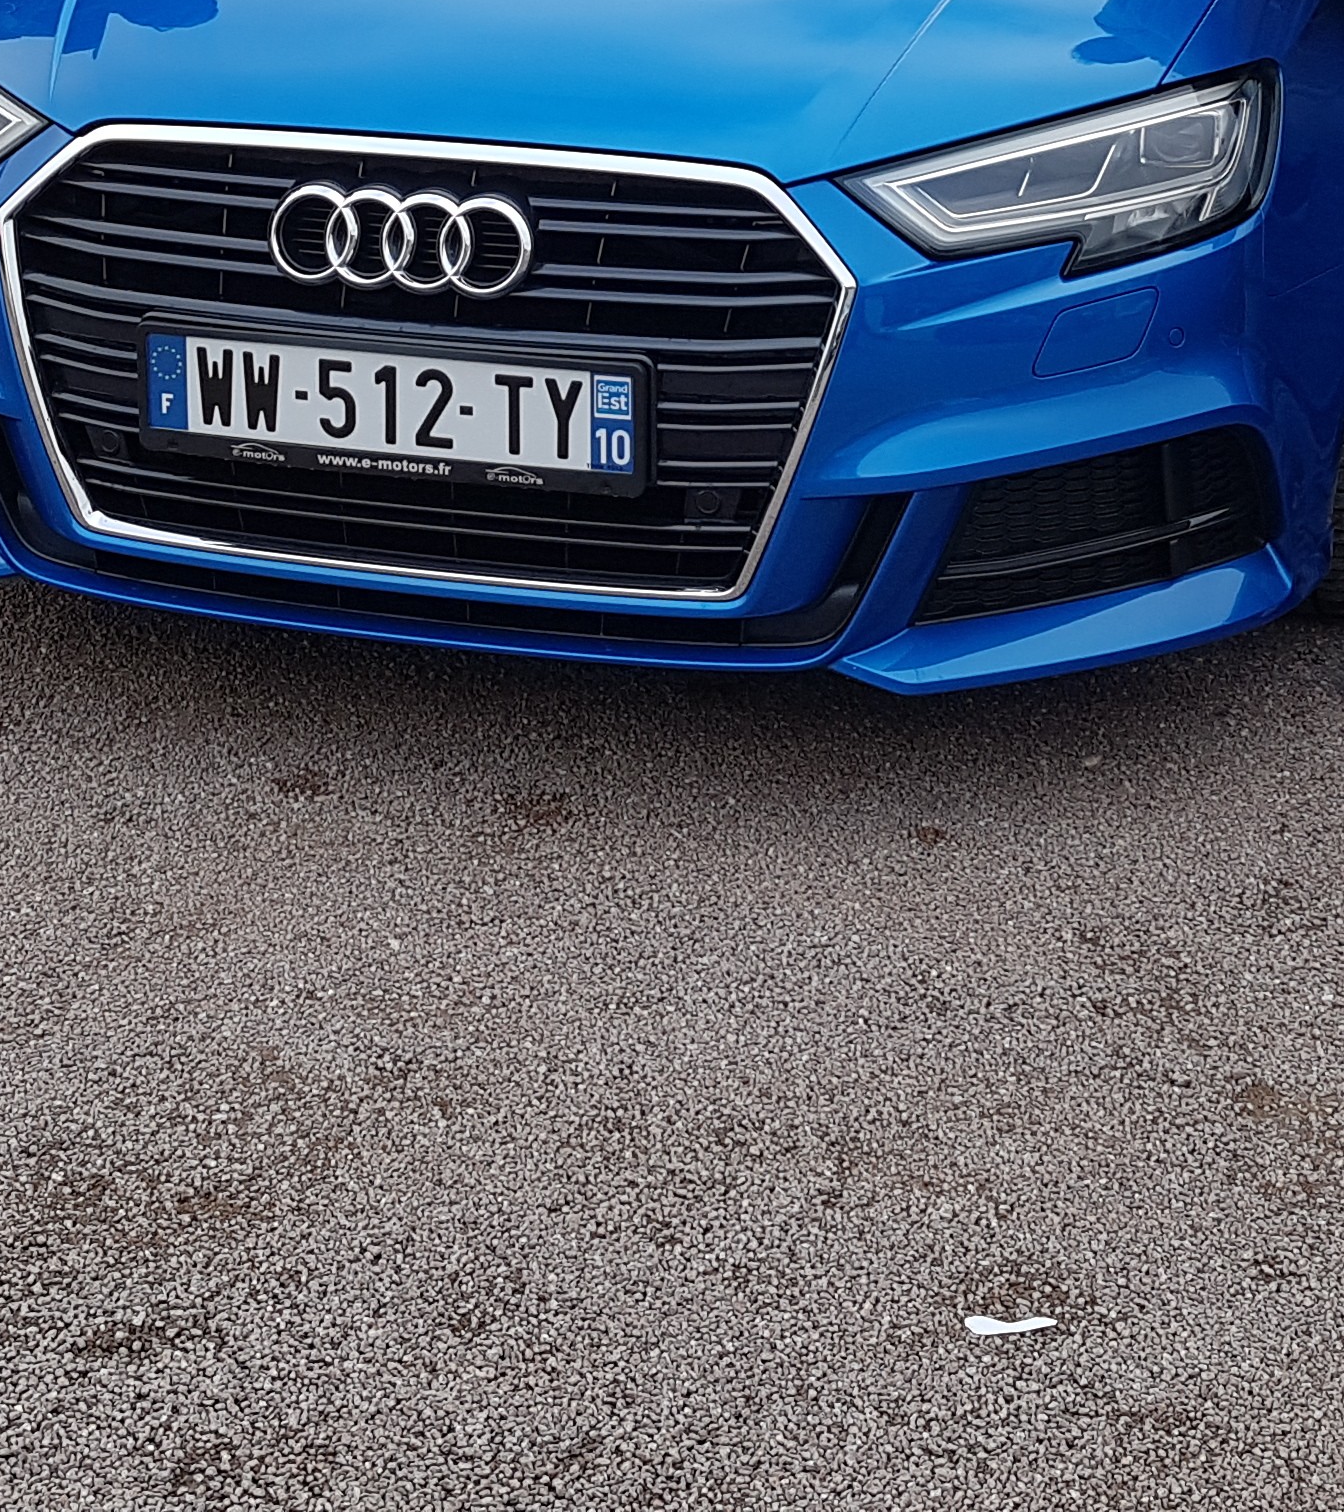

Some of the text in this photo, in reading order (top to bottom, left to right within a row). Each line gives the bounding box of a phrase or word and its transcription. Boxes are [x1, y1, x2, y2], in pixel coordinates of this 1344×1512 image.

[597, 382, 629, 394] Grand
[160, 393, 174, 415] F
[196, 345, 583, 461] WW-512-TY
[597, 392, 628, 411] Est
[595, 428, 631, 466] 10
[316, 453, 452, 476] www.e-motors.fr
